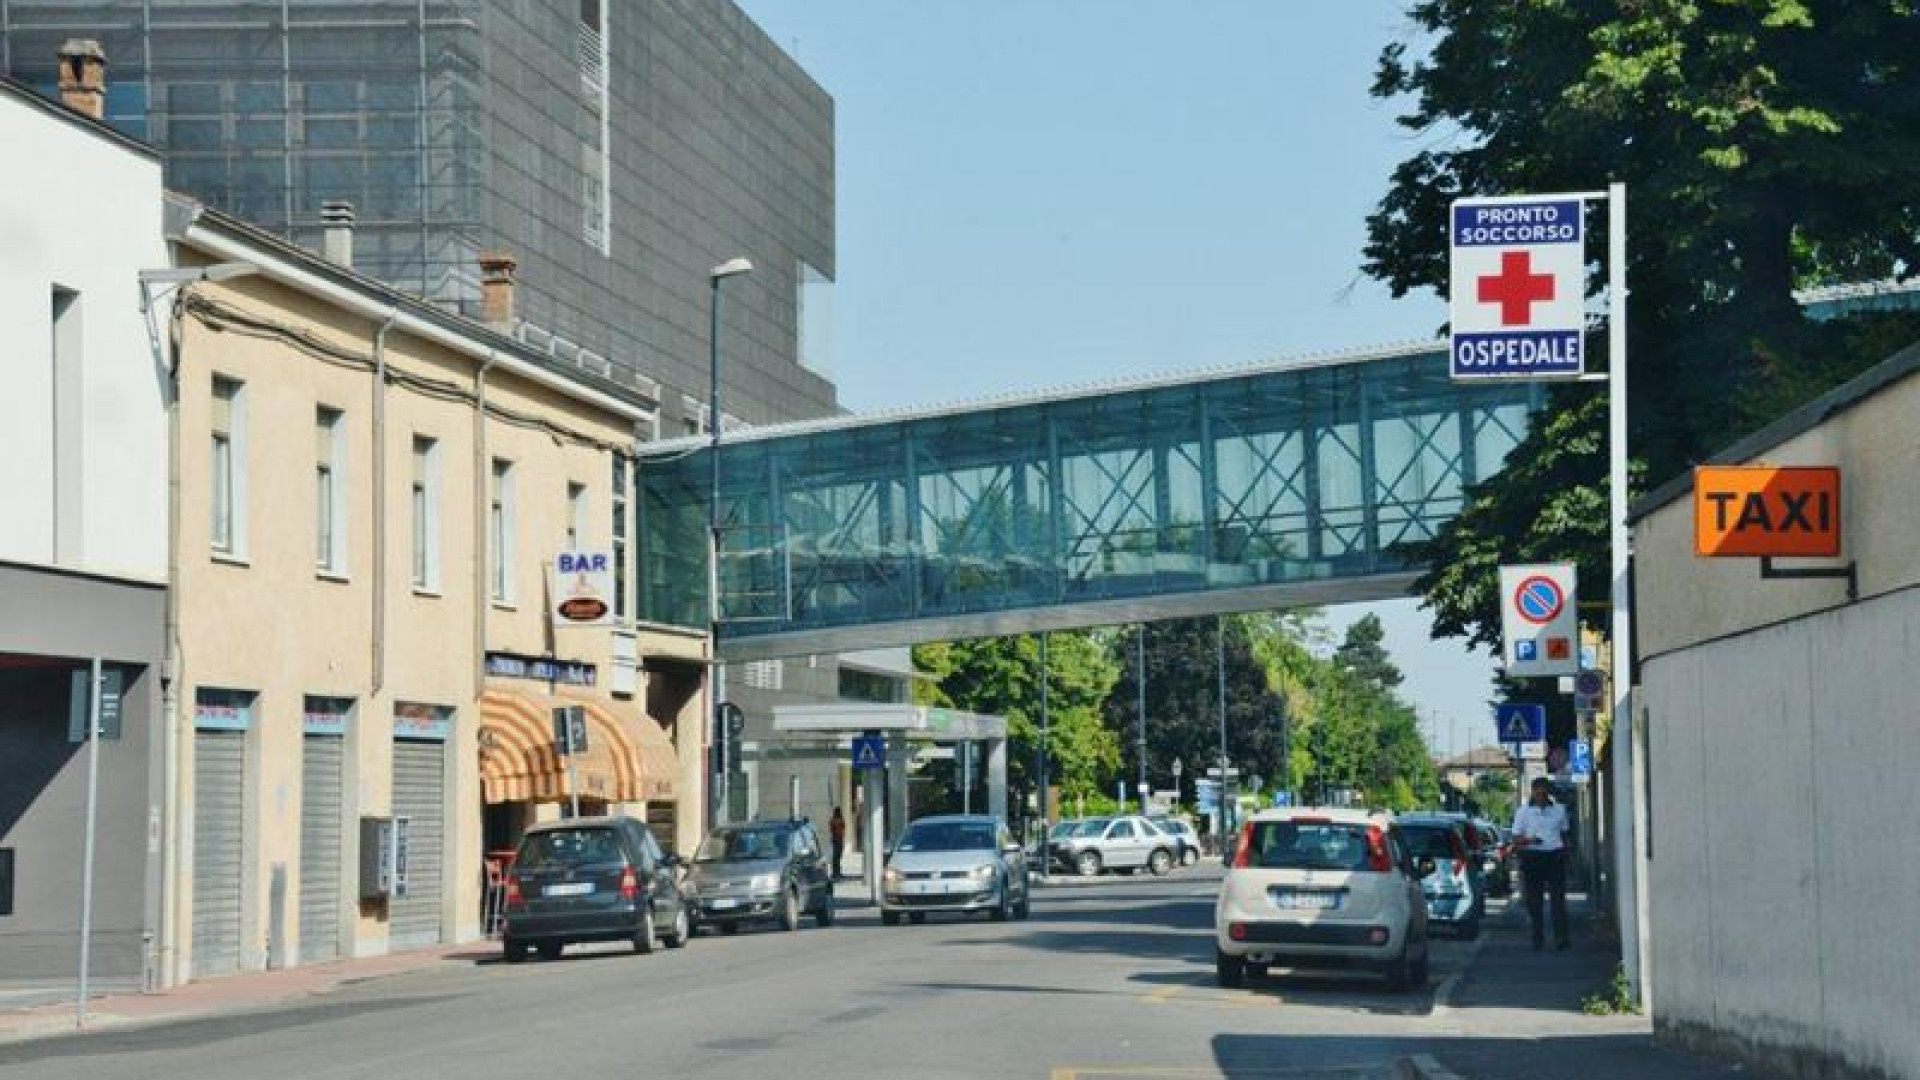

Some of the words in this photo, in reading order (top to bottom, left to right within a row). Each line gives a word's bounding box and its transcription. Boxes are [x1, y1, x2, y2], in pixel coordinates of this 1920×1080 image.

[1477, 207, 1558, 224] PRONTO
[1461, 225, 1574, 243] SOCCORSO
[1458, 337, 1578, 366] OSPEDALE
[1705, 491, 1830, 533] TAXI
[558, 553, 607, 572] BAR
